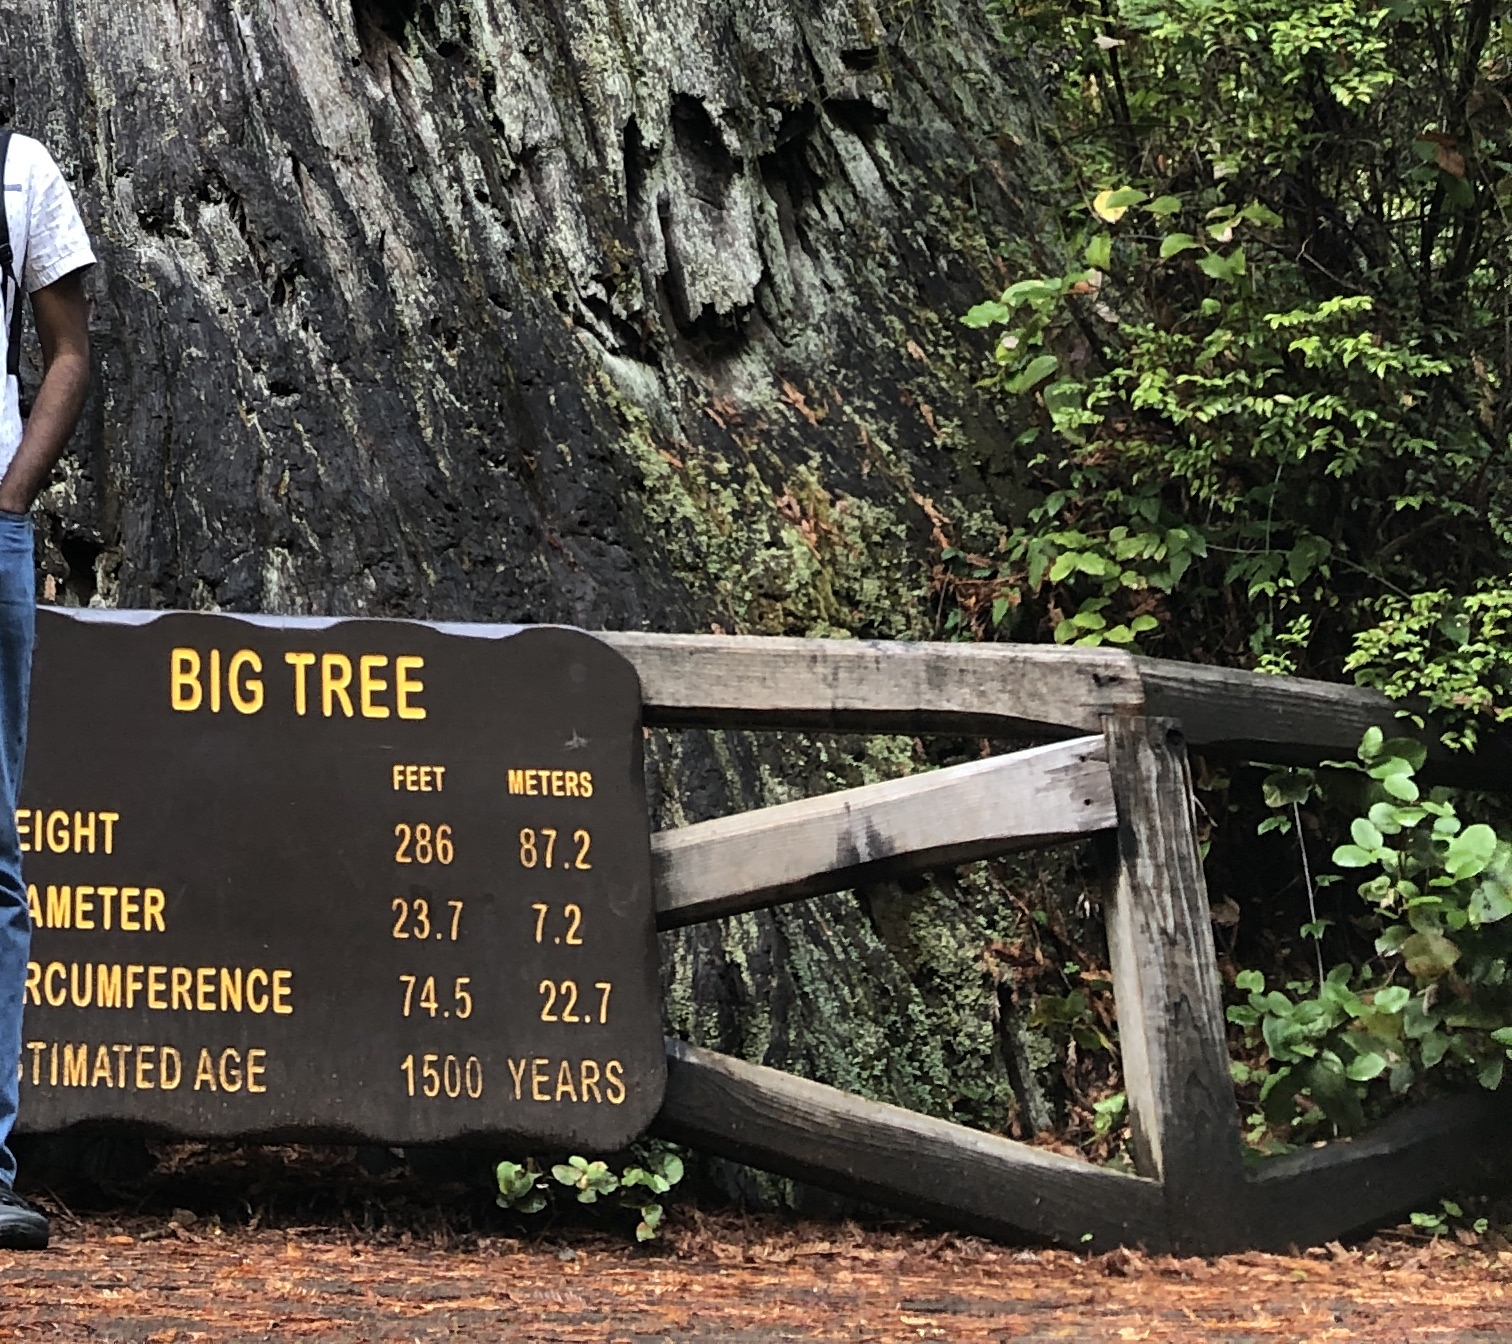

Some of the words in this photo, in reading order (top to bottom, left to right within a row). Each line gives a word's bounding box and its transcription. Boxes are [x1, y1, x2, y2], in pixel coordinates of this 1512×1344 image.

[170, 647, 265, 715] BIG
[284, 651, 427, 720] TREE
[392, 764, 446, 792] FEET
[507, 768, 594, 798] METERS
[394, 822, 454, 865] 286
[519, 827, 591, 870] 87.2
[391, 897, 464, 940] 23.7
[532, 902, 583, 945] 7.2
[399, 974, 473, 1019] 74.5
[539, 979, 612, 1024] 22.7
[17, 1041, 182, 1090] TIMATED
[193, 1047, 267, 1094] AGE
[401, 1053, 483, 1099] 1500
[507, 1058, 626, 1105] YEARS
